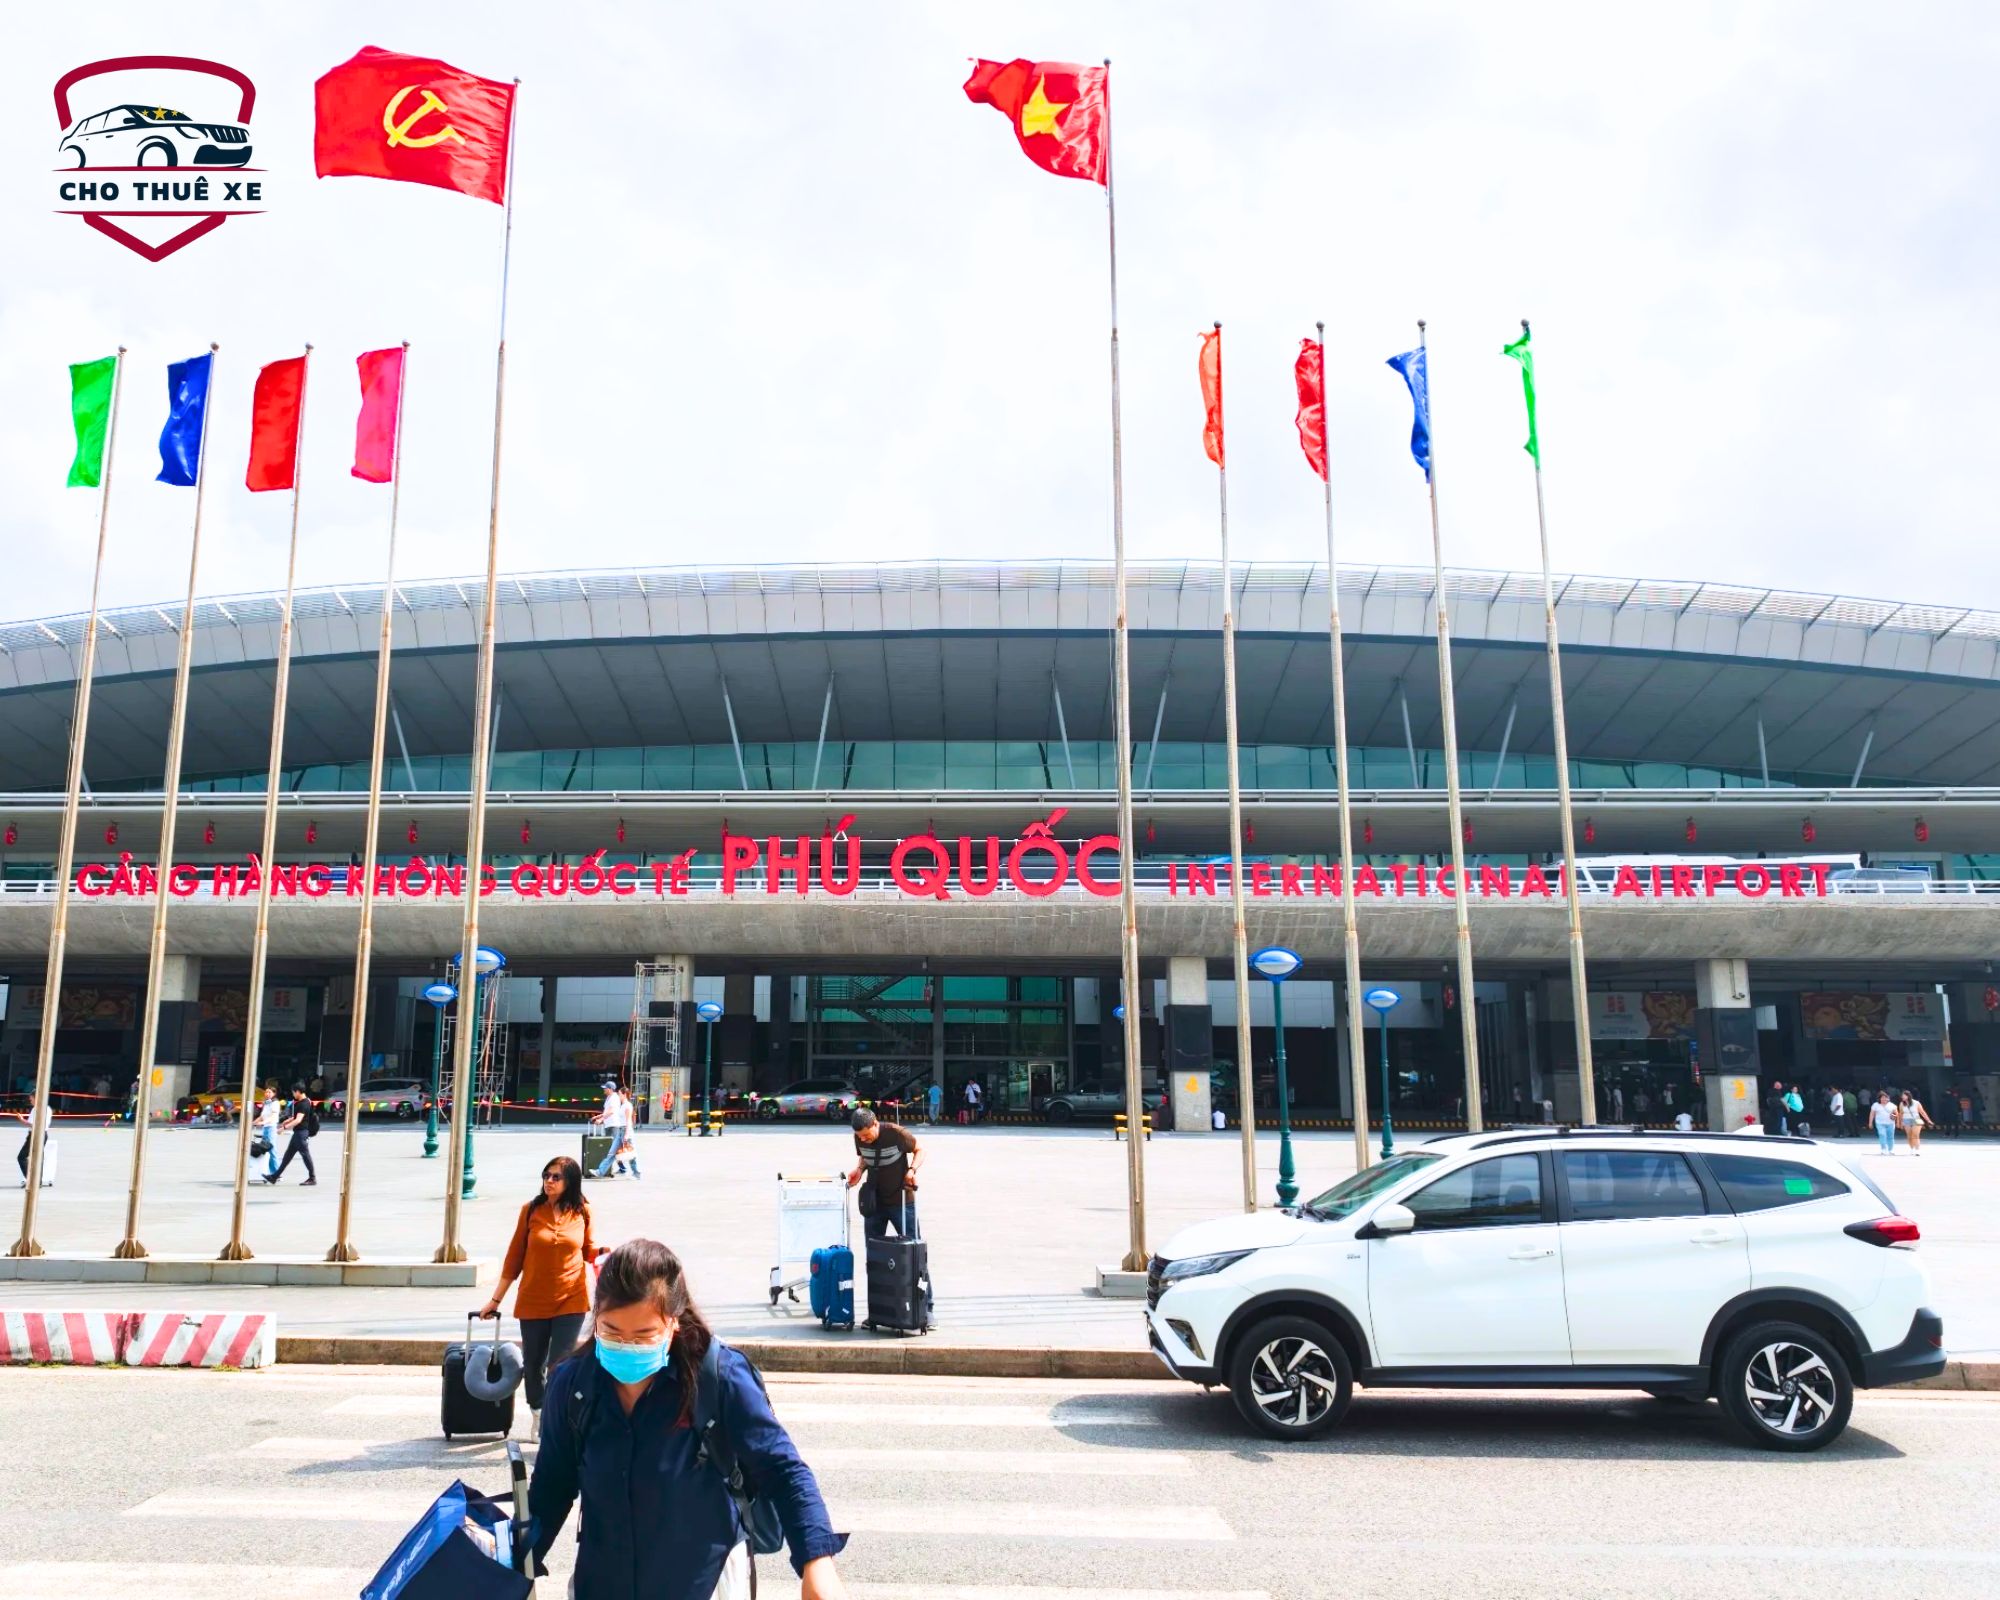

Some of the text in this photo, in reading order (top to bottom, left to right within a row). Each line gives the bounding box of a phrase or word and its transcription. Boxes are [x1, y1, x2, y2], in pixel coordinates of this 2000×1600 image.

[76, 851, 200, 897] CẢNG
[212, 852, 333, 897] HÀNG
[346, 855, 498, 897] KHÔNG
[510, 848, 638, 898] QUỐC
[650, 848, 698, 895] TẾ
[722, 813, 861, 895] PHÚ
[890, 807, 1122, 899] QUỐC
[1613, 864, 1831, 898] AIRPORT
